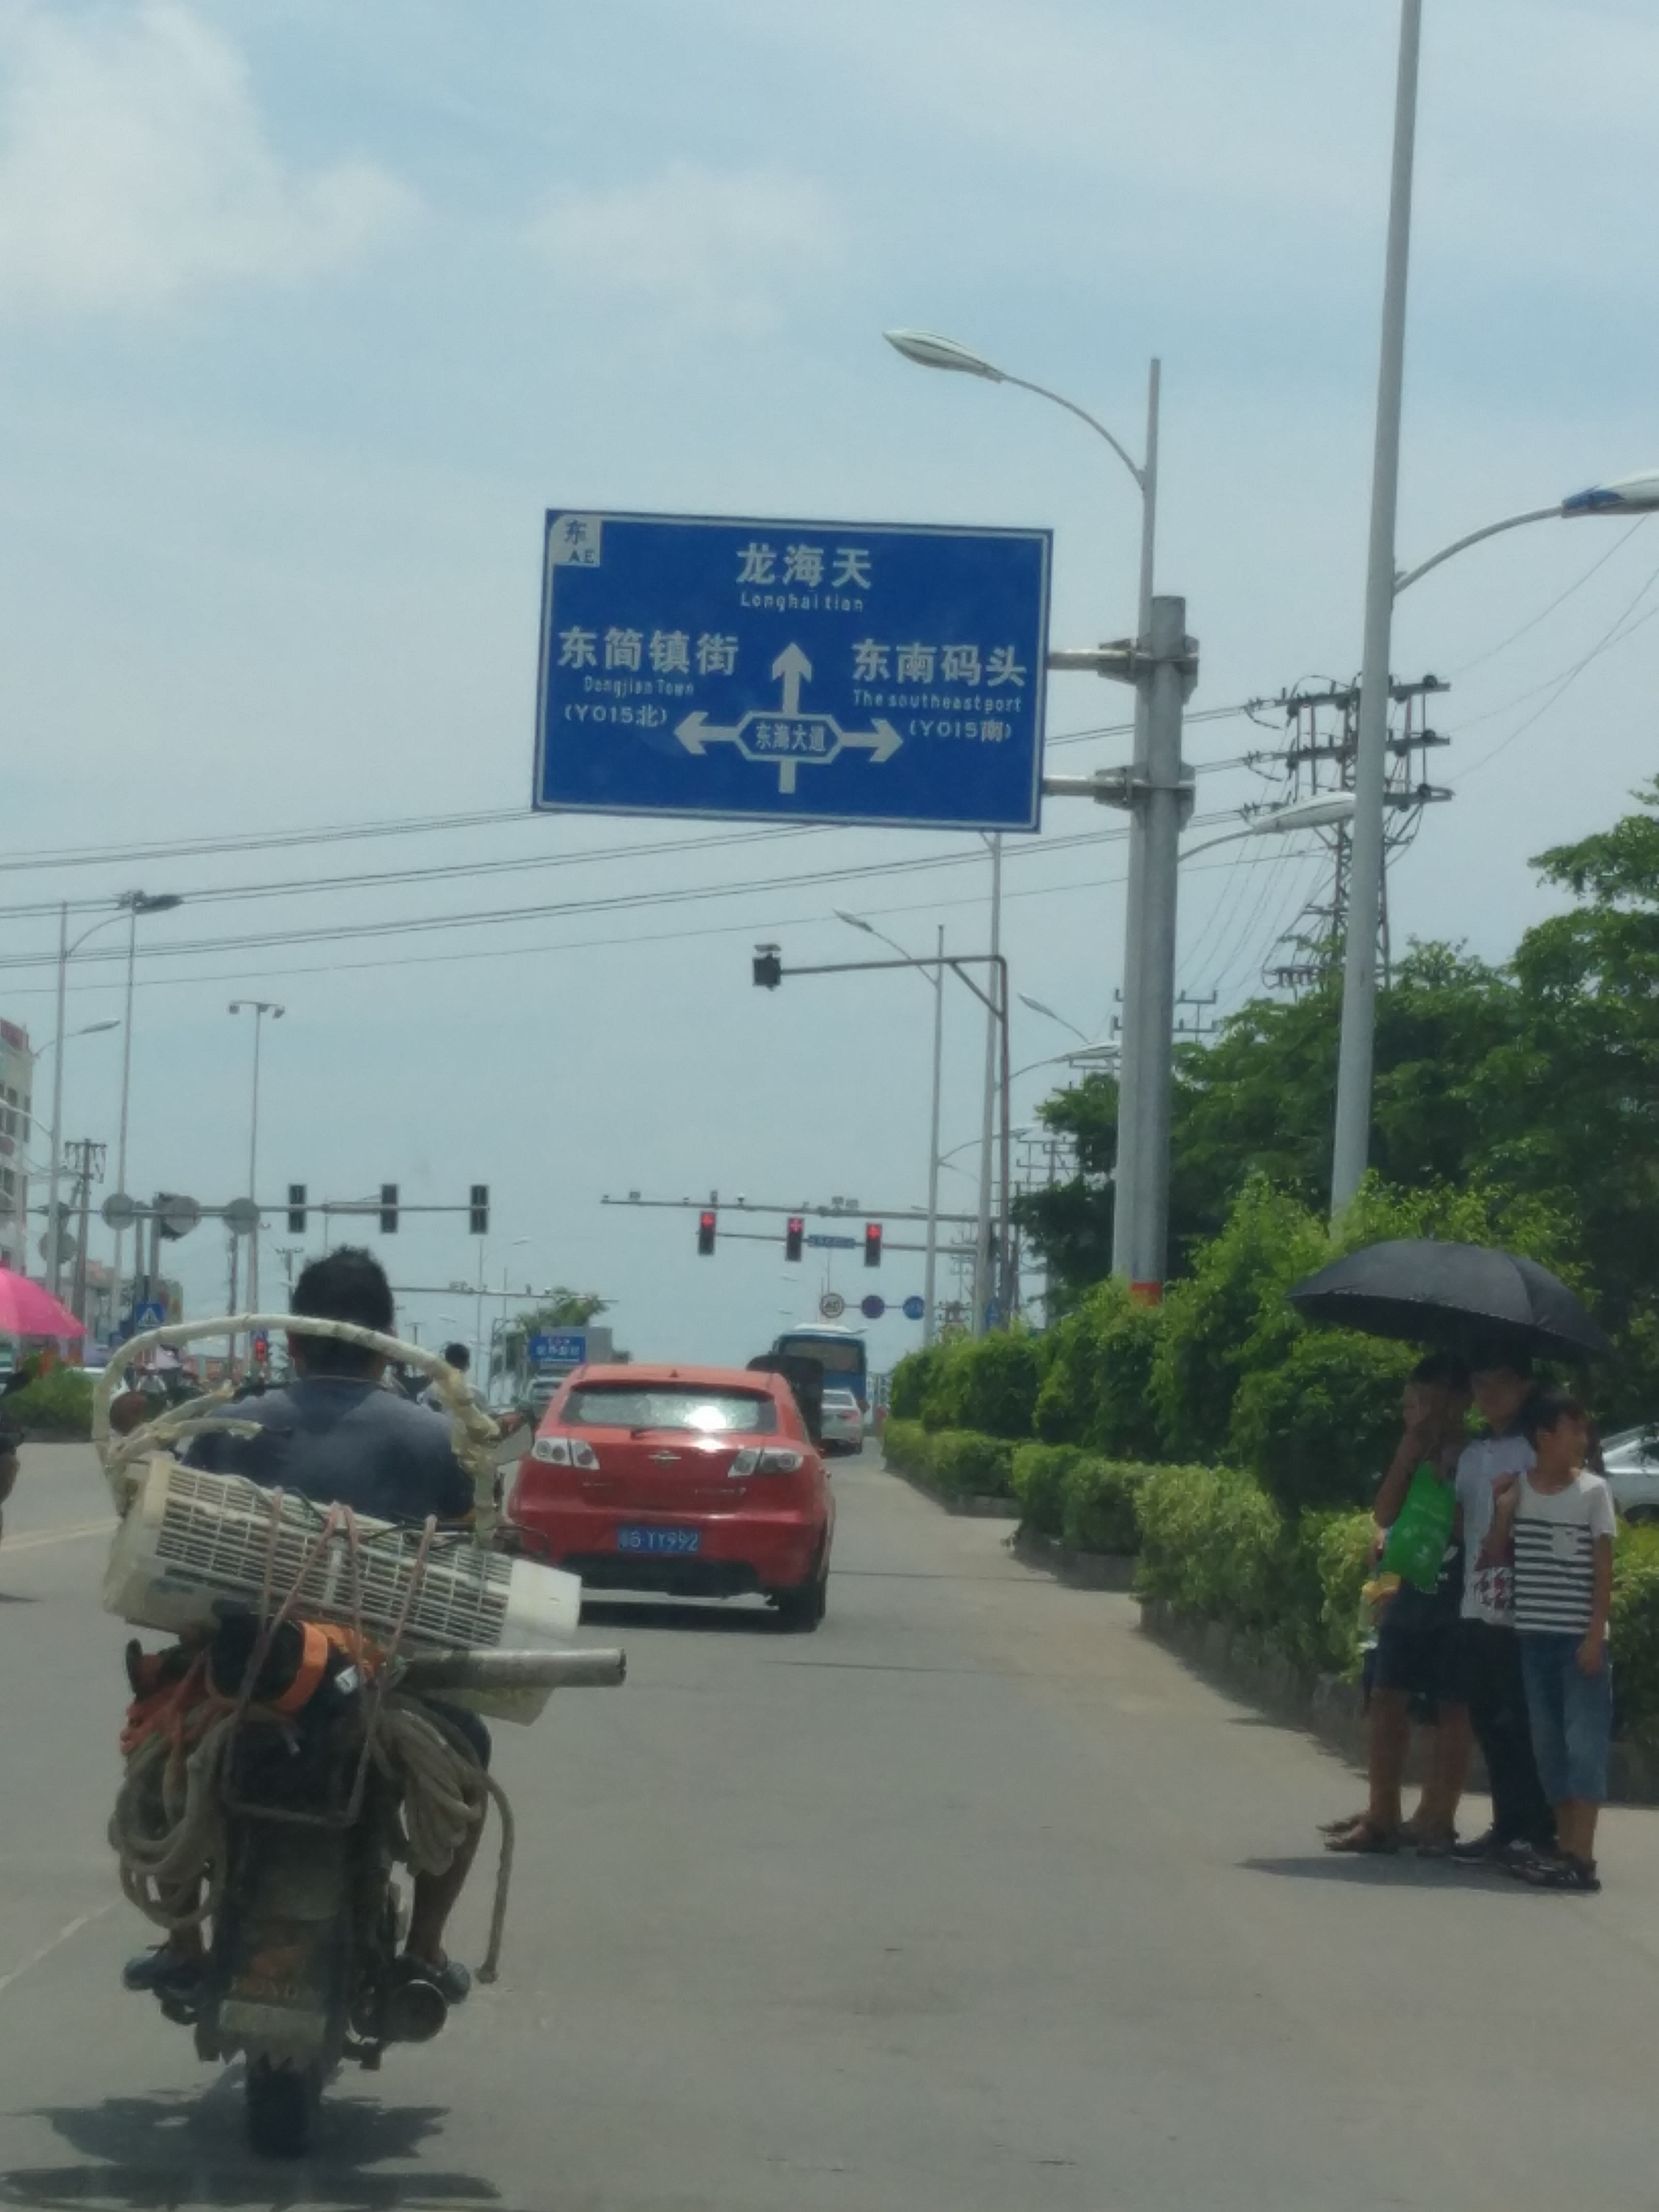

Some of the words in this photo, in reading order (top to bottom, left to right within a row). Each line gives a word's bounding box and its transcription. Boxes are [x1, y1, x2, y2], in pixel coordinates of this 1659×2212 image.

[564, 519, 588, 546] 东
[735, 542, 871, 589] 龙海天
[558, 626, 740, 676] 东简镇街
[850, 638, 1027, 686] 东南码头
